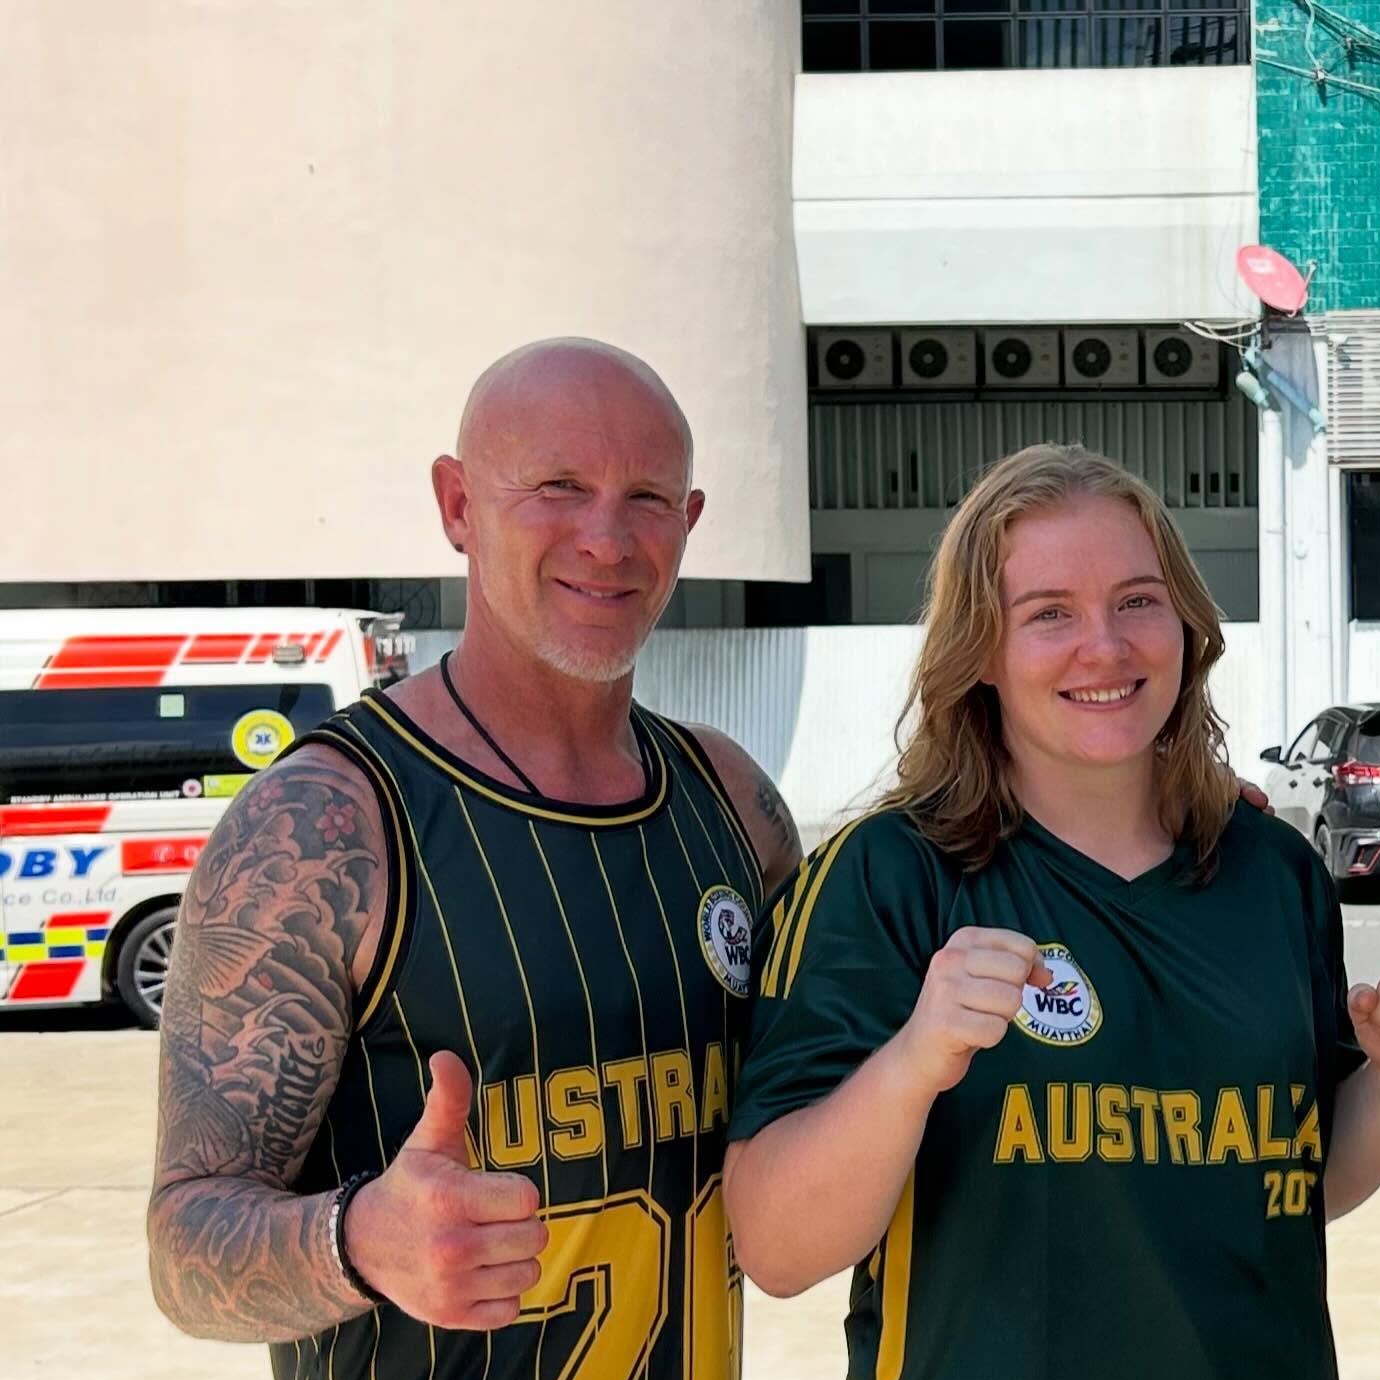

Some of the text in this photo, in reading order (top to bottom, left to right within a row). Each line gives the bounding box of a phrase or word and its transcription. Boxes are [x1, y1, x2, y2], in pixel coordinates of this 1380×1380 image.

[1034, 993, 1084, 1017] WBC
[1027, 1018, 1093, 1041] MUAYTHAI
[464, 1041, 741, 1170] USTRA
